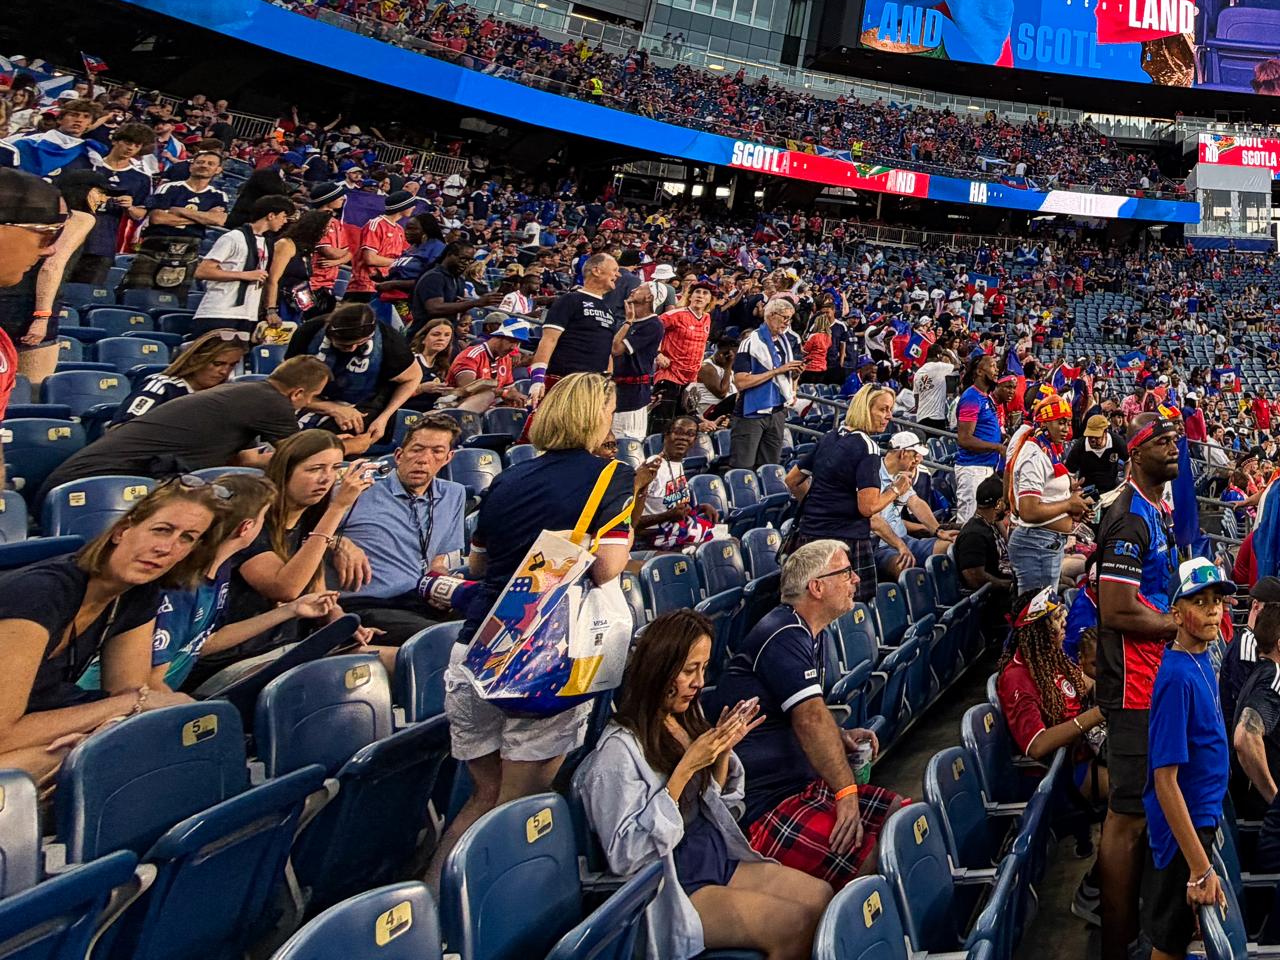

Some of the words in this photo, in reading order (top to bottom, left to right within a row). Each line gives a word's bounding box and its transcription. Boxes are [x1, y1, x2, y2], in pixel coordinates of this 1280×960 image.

[877, 2, 943, 48] AND
[1242, 150, 1278, 167] SCOTLA
[192, 720, 201, 733] 5
[532, 814, 540, 828] 5
[866, 898, 873, 913] 5
[385, 910, 395, 926] 4
